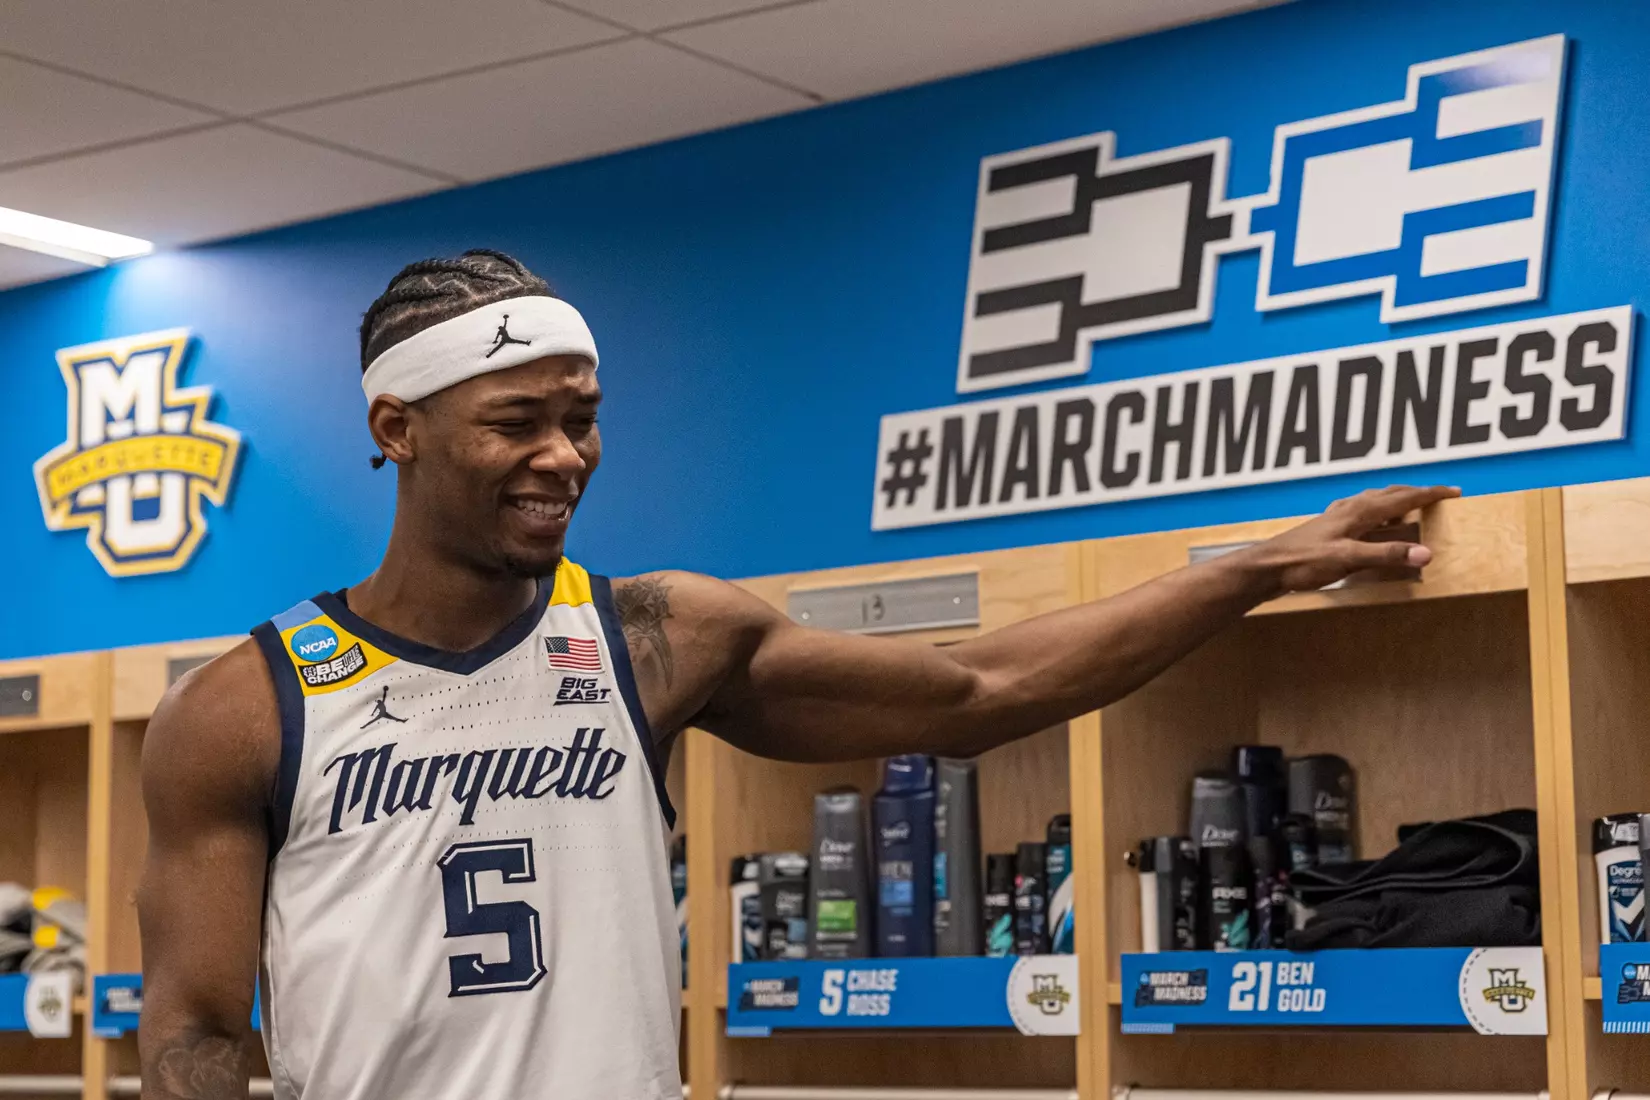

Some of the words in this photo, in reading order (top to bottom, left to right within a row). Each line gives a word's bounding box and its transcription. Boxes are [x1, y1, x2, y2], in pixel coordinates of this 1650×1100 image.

[881, 320, 1618, 511] #MARCHMADNESS
[299, 637, 337, 655] NCAA
[307, 656, 364, 684] CHANGE
[315, 657, 345, 677] BE
[556, 688, 612, 701] EAST
[560, 677, 598, 690] BIG
[323, 728, 627, 835] Marquette
[436, 838, 548, 998] 5
[847, 969, 899, 992] CHASE
[1276, 961, 1315, 986] BEN
[819, 969, 846, 1016] 5
[1154, 986, 1208, 1001] MADNESS
[1228, 961, 1273, 1012] 21
[847, 994, 891, 1017] ROSS
[1276, 988, 1327, 1013] GOLD
